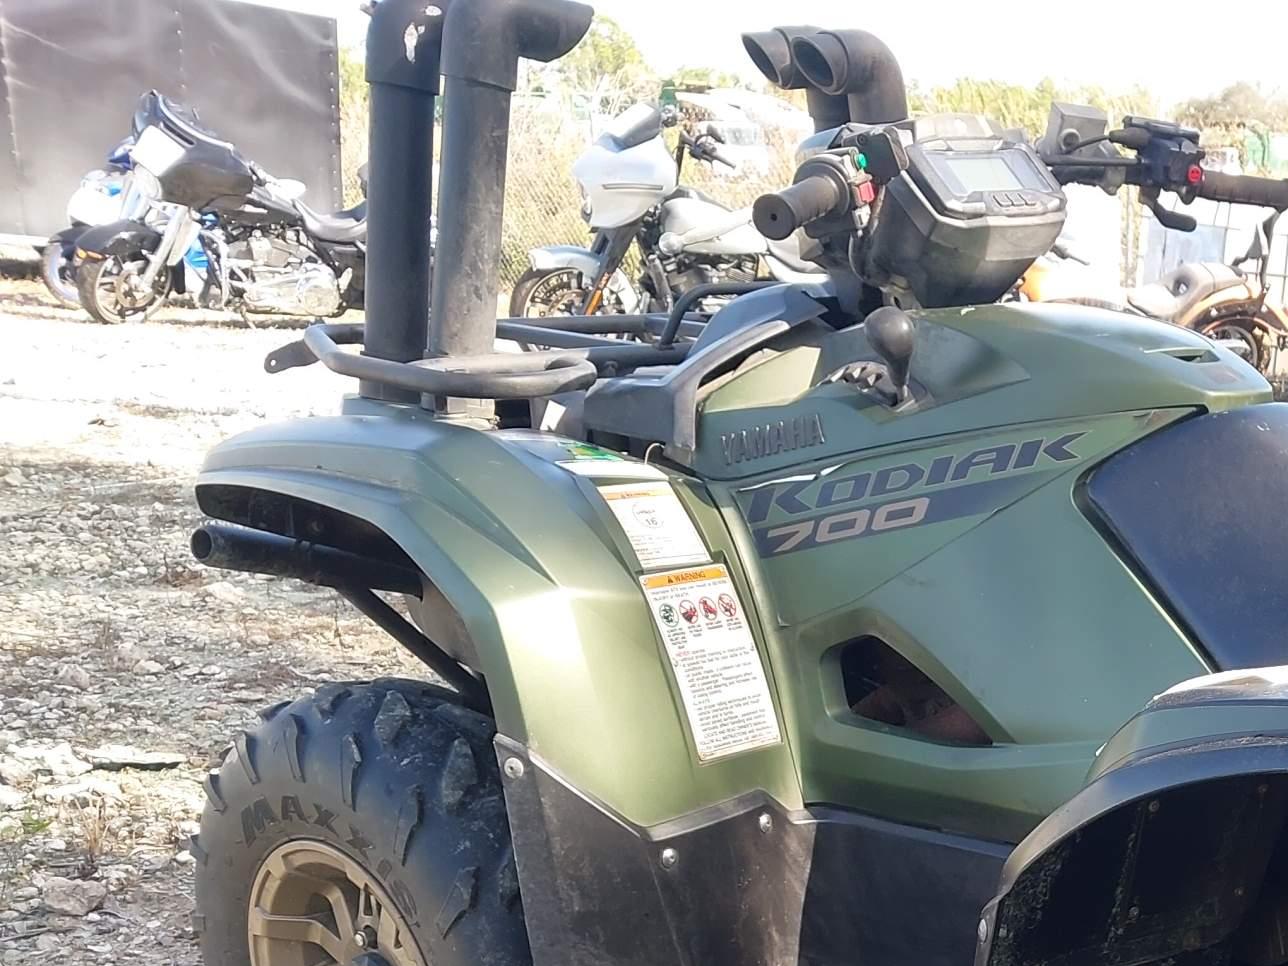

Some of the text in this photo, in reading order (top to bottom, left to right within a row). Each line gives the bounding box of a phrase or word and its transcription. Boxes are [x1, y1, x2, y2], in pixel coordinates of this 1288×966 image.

[720, 414, 826, 466] YAMAHA
[751, 430, 1092, 523] KODIAK
[766, 497, 930, 553] 700
[675, 570, 706, 582] WARNING
